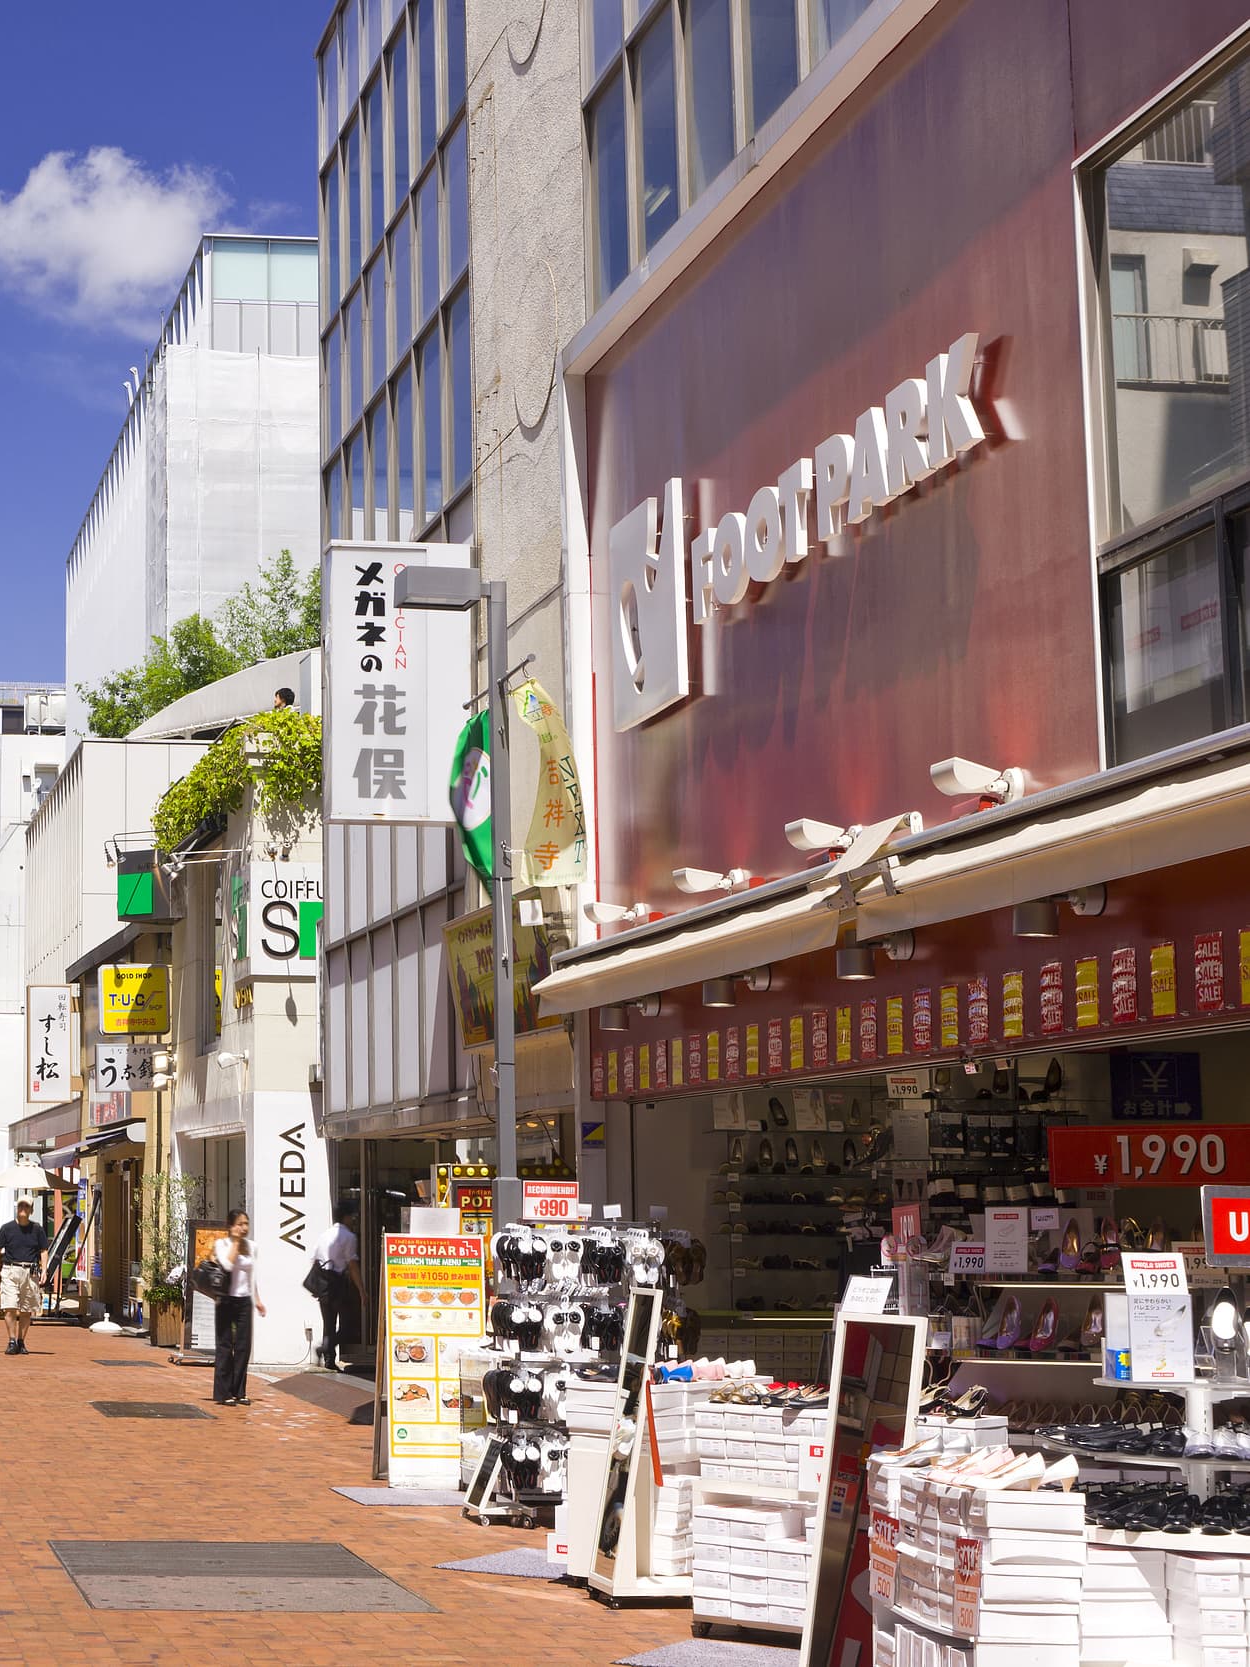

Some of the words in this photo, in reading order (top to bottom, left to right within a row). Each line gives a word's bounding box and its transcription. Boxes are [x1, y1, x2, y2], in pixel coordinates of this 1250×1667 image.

[692, 457, 814, 625] FOOT
[815, 333, 985, 541] PARK
[533, 756, 566, 871] 吉祥寺
[1198, 941, 1220, 957] SALE!
[1153, 976, 1173, 993] SALE
[1199, 986, 1221, 1003] SALE!
[36, 1014, 60, 1081] すし松
[1123, 1100, 1172, 1116] お会計
[1094, 1134, 1226, 1180] ¥1,990
[278, 1121, 306, 1251] AVEDA
[534, 1199, 569, 1218] ¥990
[389, 1244, 457, 1256] POTOHAR
[459, 1247, 469, 1256] B1
[954, 1257, 984, 1268] ¥1,990
[420, 1271, 449, 1280] ¥1050
[1133, 1273, 1180, 1288] ¥1,990
[874, 1524, 899, 1547] SALE
[958, 1549, 980, 1570] SALE
